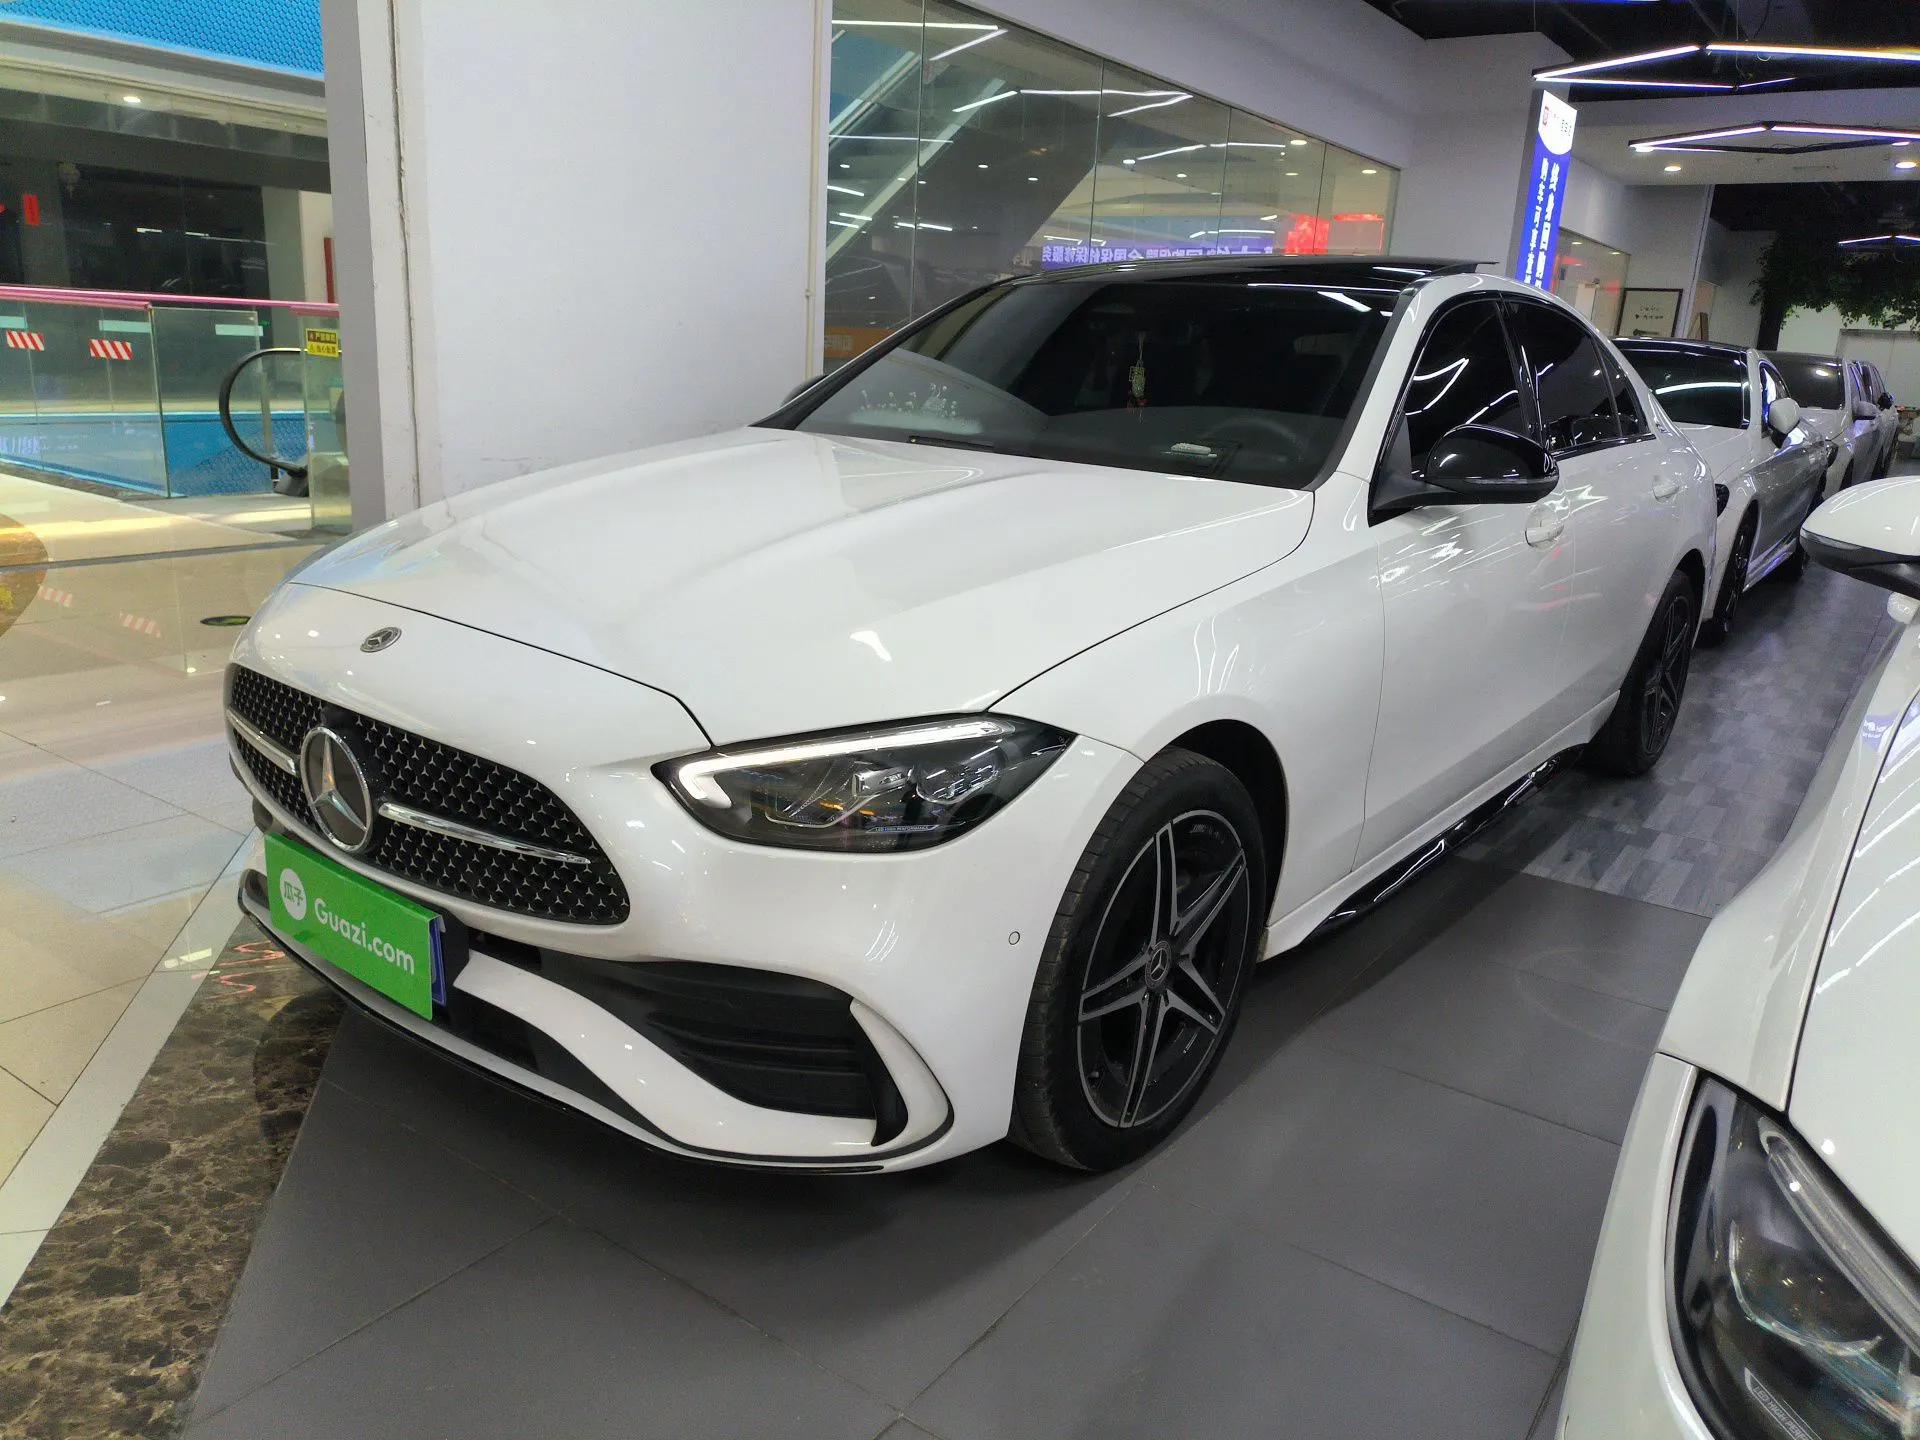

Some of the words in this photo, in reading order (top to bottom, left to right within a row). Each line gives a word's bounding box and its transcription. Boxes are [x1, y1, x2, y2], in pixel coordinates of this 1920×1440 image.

[283, 880, 304, 907] 瓜子
[314, 897, 415, 975] Guazi.com
[1752, 1386, 1769, 1402] LED
